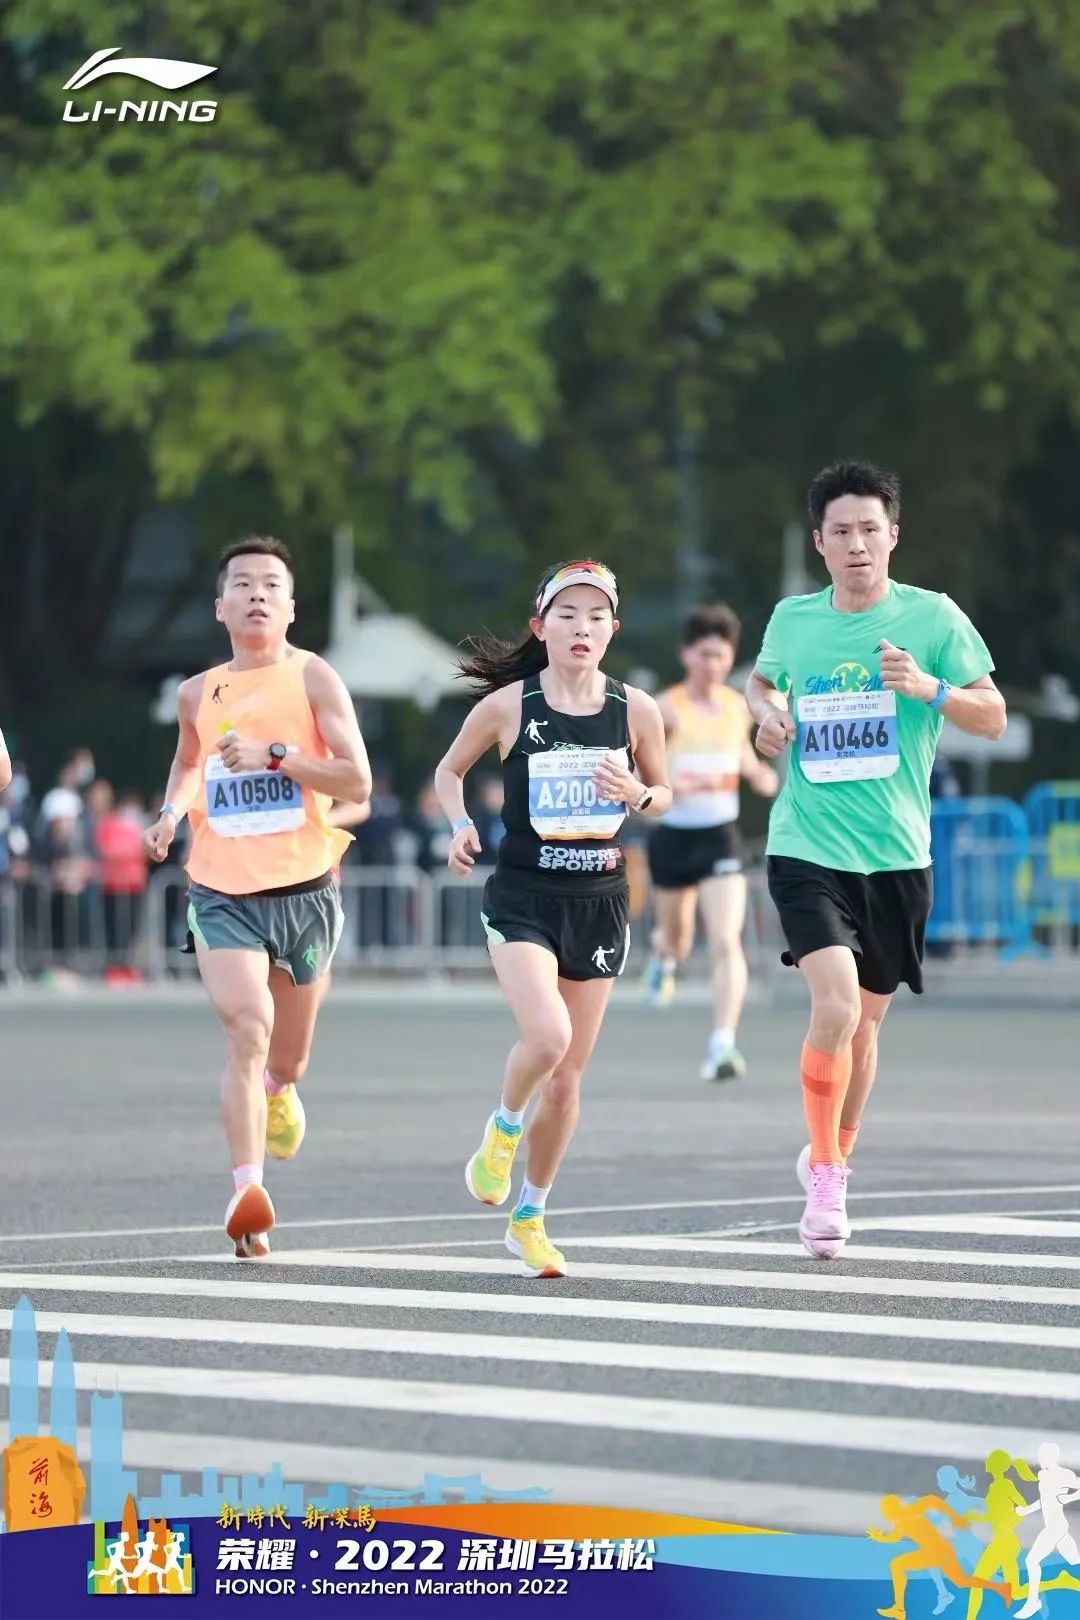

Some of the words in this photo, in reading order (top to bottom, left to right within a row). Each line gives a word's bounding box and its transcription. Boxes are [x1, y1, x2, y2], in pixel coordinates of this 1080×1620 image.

[805, 721, 889, 752] A10466
[214, 776, 294, 808] A10508
[537, 780, 622, 809] A200
[538, 856, 606, 871] SPORT
